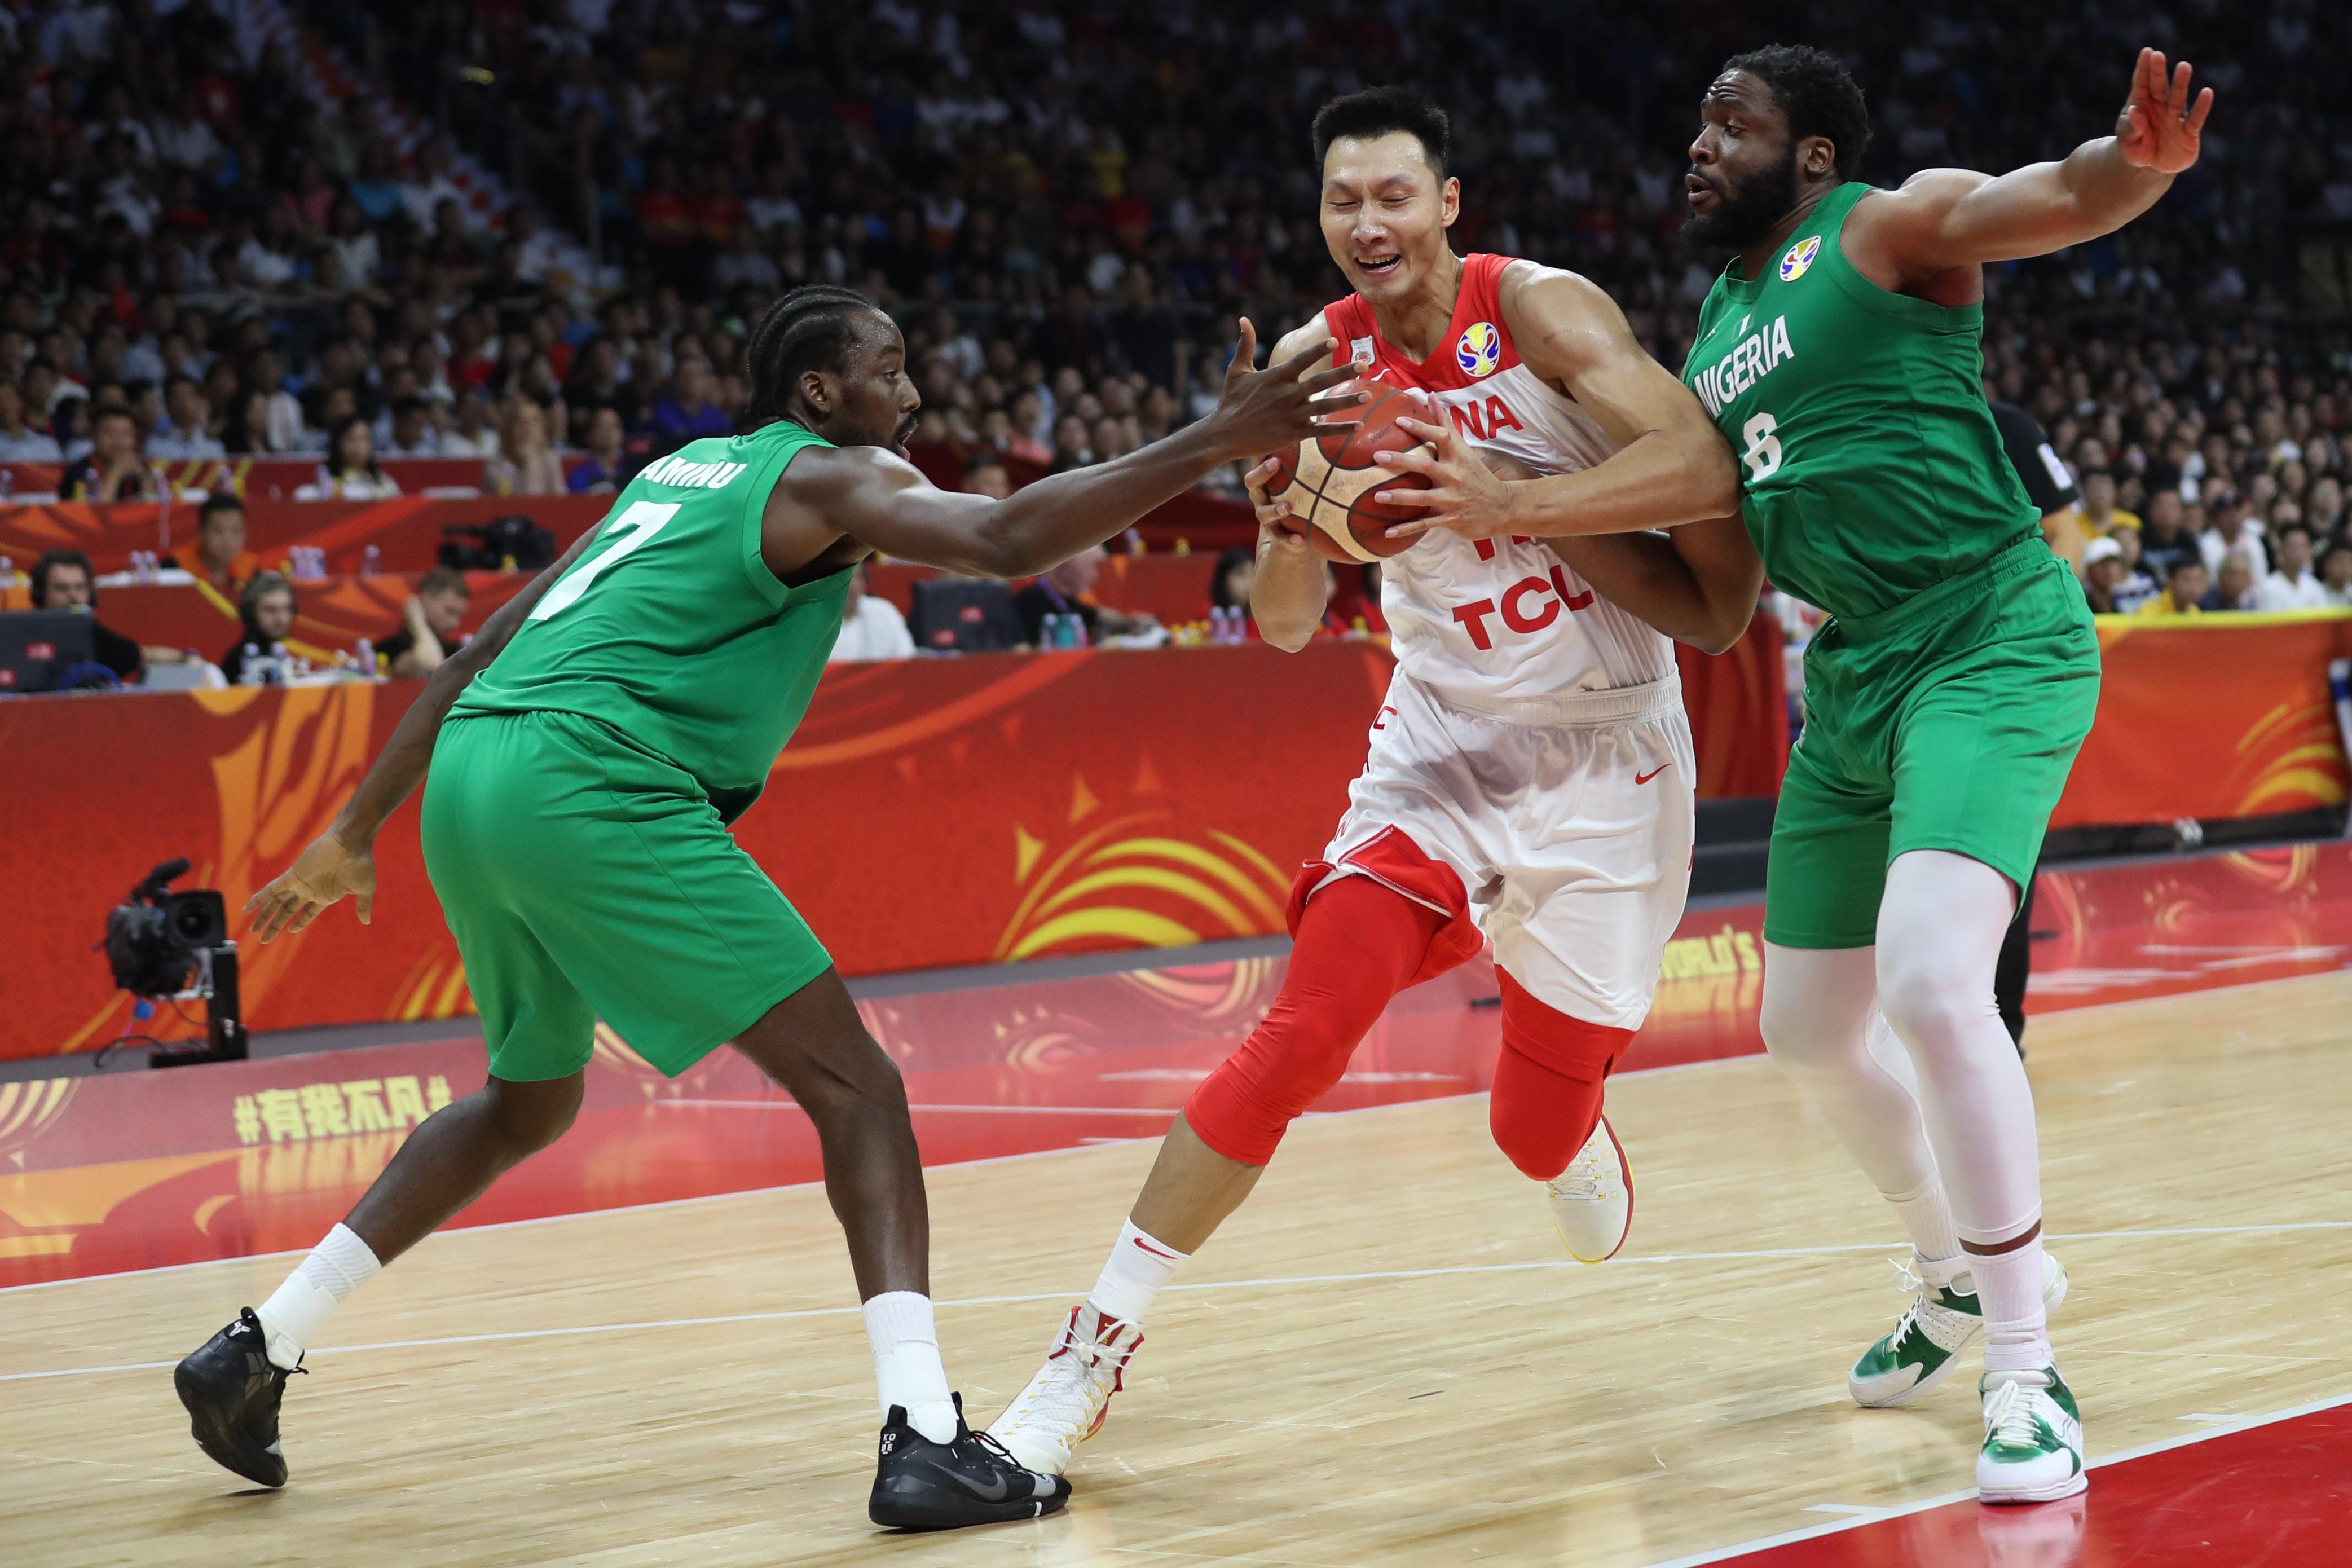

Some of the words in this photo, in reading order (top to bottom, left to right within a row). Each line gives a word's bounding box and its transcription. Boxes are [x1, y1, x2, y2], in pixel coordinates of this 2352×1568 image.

[1694, 315, 1795, 419] NIGERIA
[635, 455, 748, 490] AMINU
[528, 501, 682, 620] 7
[1452, 565, 1595, 650] TCL
